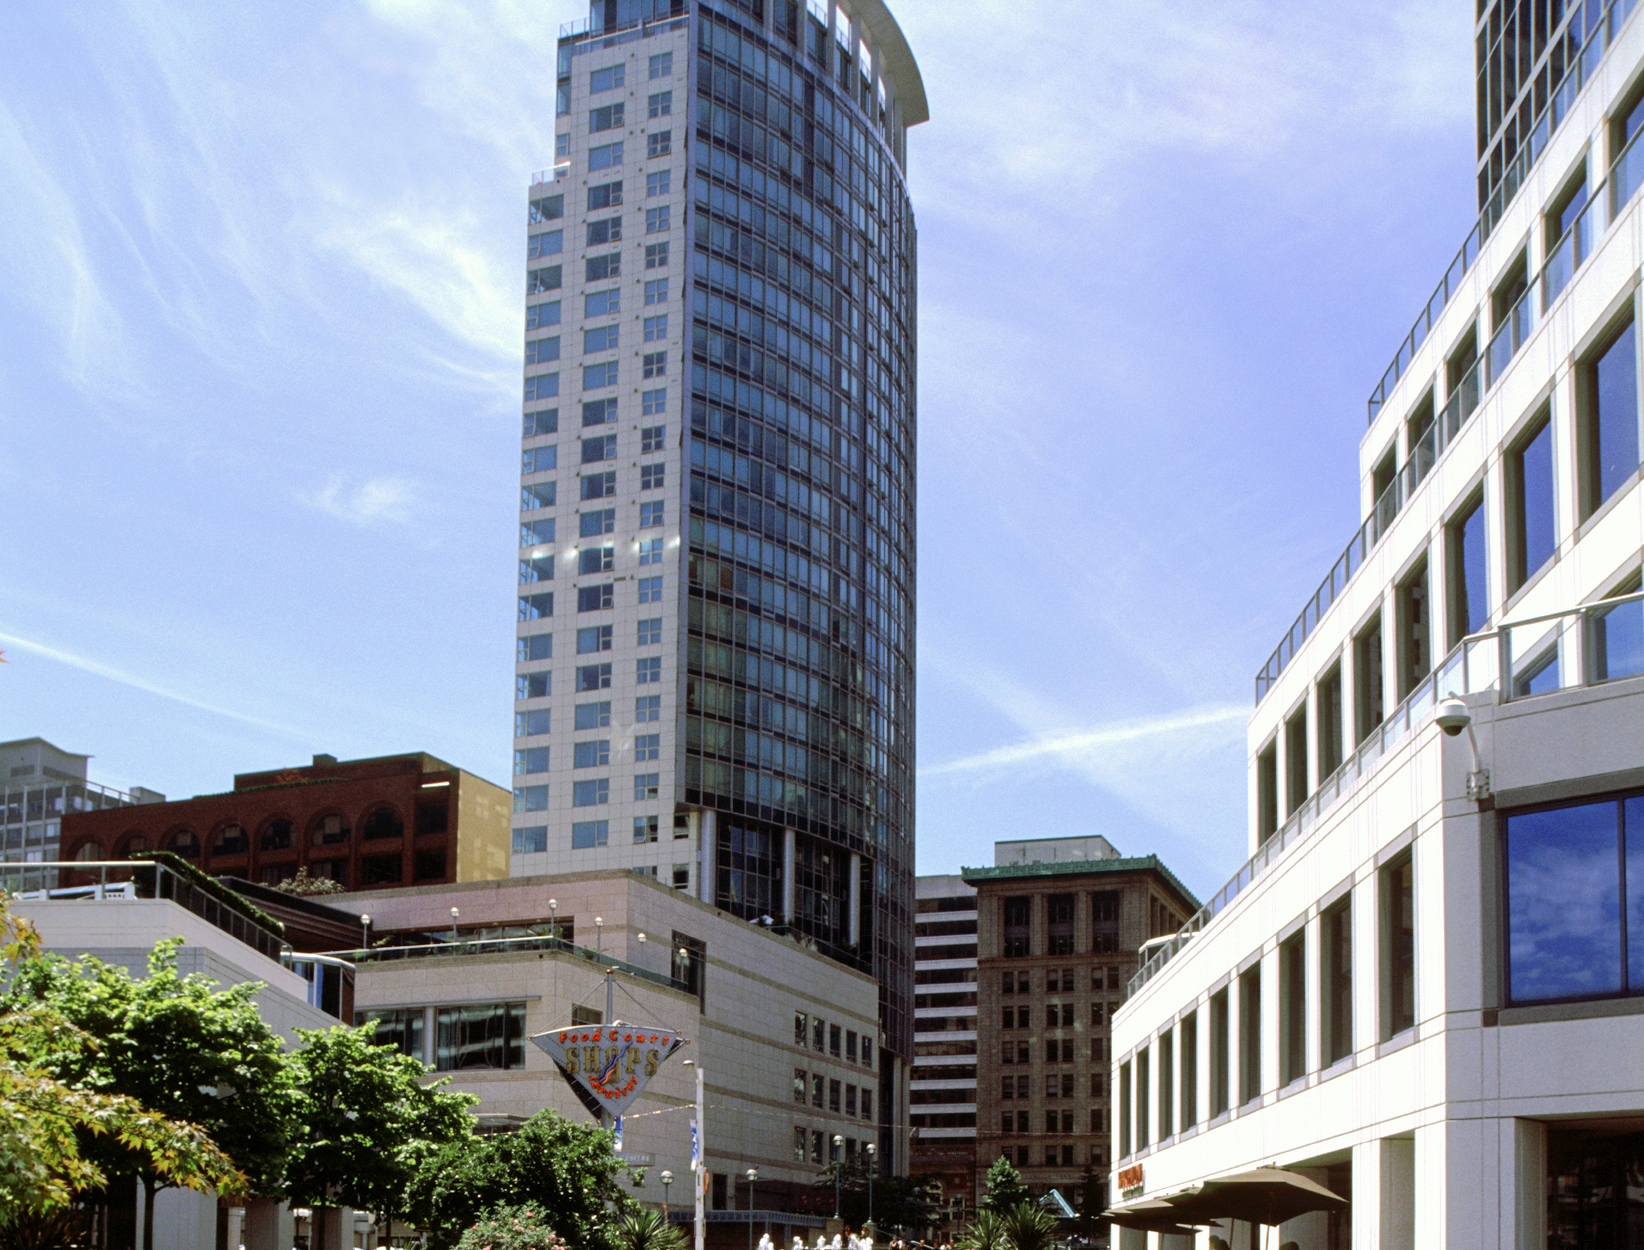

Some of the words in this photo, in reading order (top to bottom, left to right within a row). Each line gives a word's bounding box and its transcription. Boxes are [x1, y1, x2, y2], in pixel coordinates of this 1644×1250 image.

[560, 1027, 602, 1044] Food
[609, 1029, 670, 1046] Court
[565, 1045, 659, 1083] SHOPS
